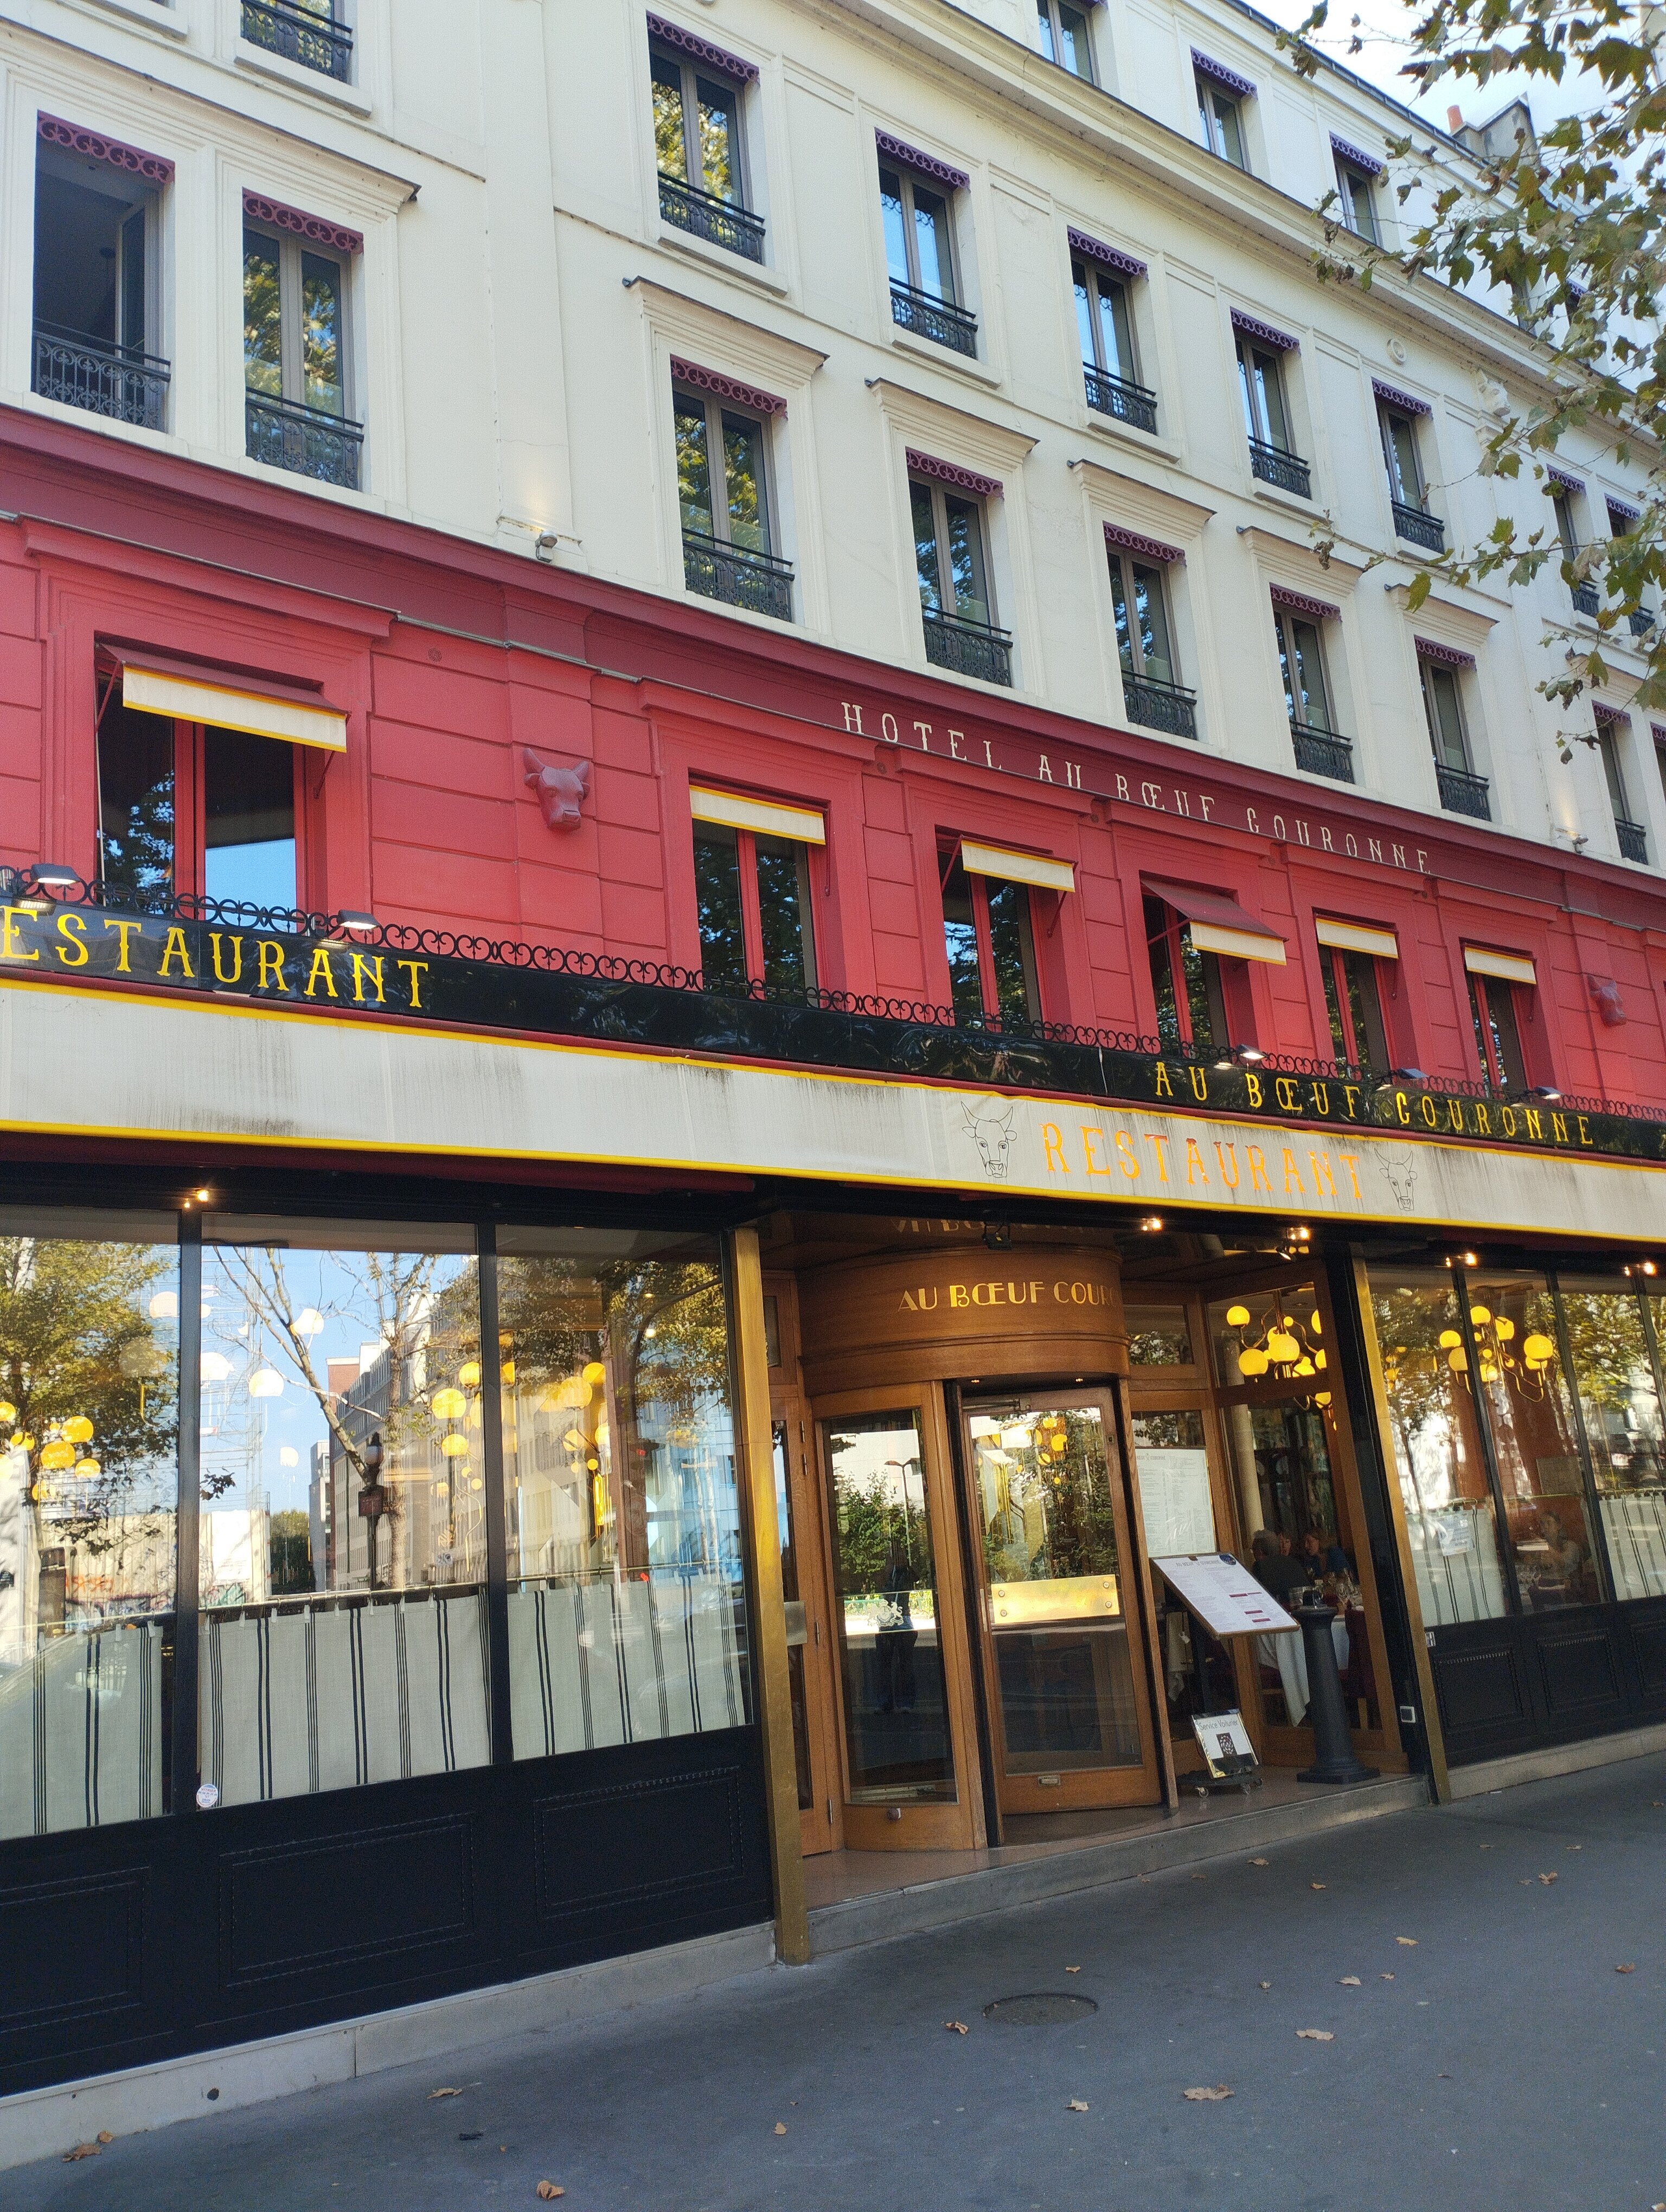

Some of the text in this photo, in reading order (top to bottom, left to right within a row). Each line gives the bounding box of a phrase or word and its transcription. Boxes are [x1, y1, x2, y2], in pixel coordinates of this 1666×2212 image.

[841, 702, 1432, 874] HOTEL AU BŒUF COURONNE
[1156, 1061, 1594, 1146] AU BŒUF COURONNE
[1039, 1122, 1362, 1199] RESTAURANT
[898, 1286, 938, 1311] AU
[949, 1281, 1046, 1308] BŒUF
